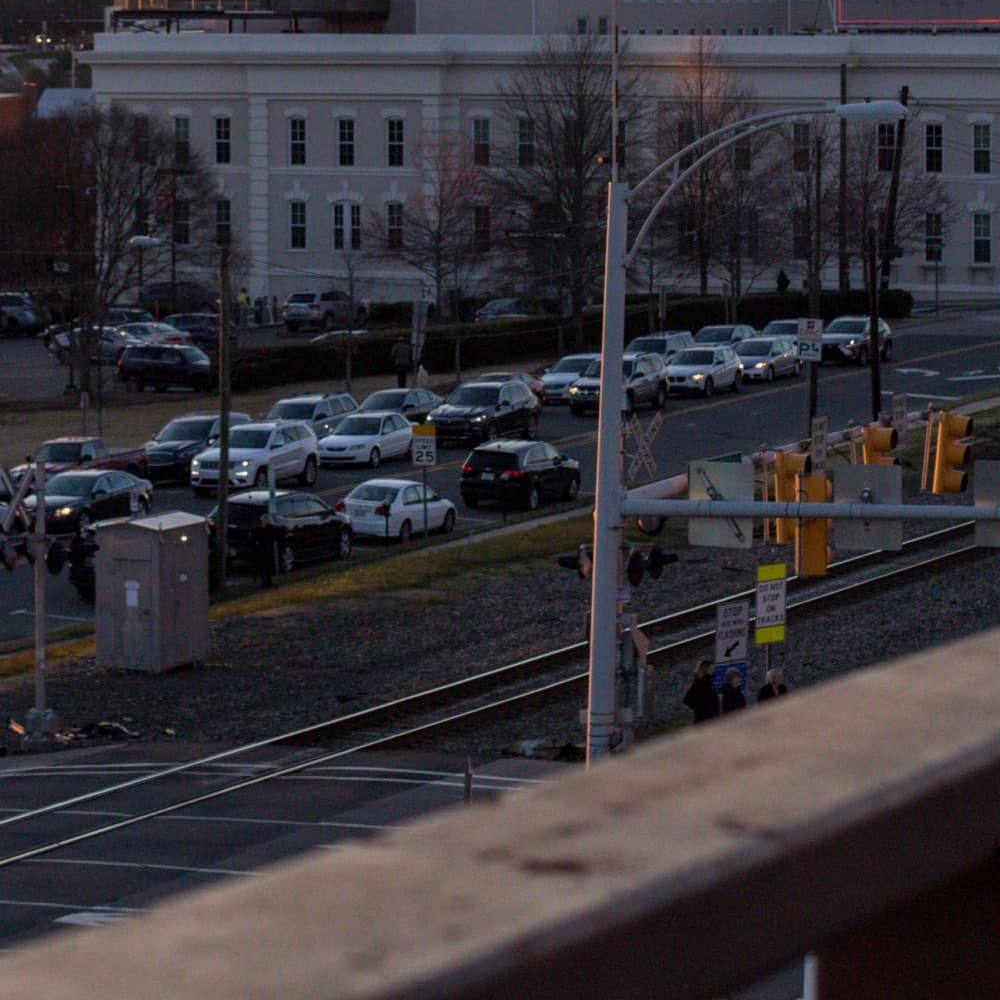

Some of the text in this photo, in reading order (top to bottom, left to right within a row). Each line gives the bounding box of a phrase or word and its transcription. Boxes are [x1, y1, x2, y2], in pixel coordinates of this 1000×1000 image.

[415, 450, 434, 463] 25
[759, 581, 784, 593] DO NOT
[763, 593, 780, 603] STOP
[723, 606, 743, 618] STOP
[766, 604, 776, 613] ON
[757, 613, 784, 626] TRACKS
